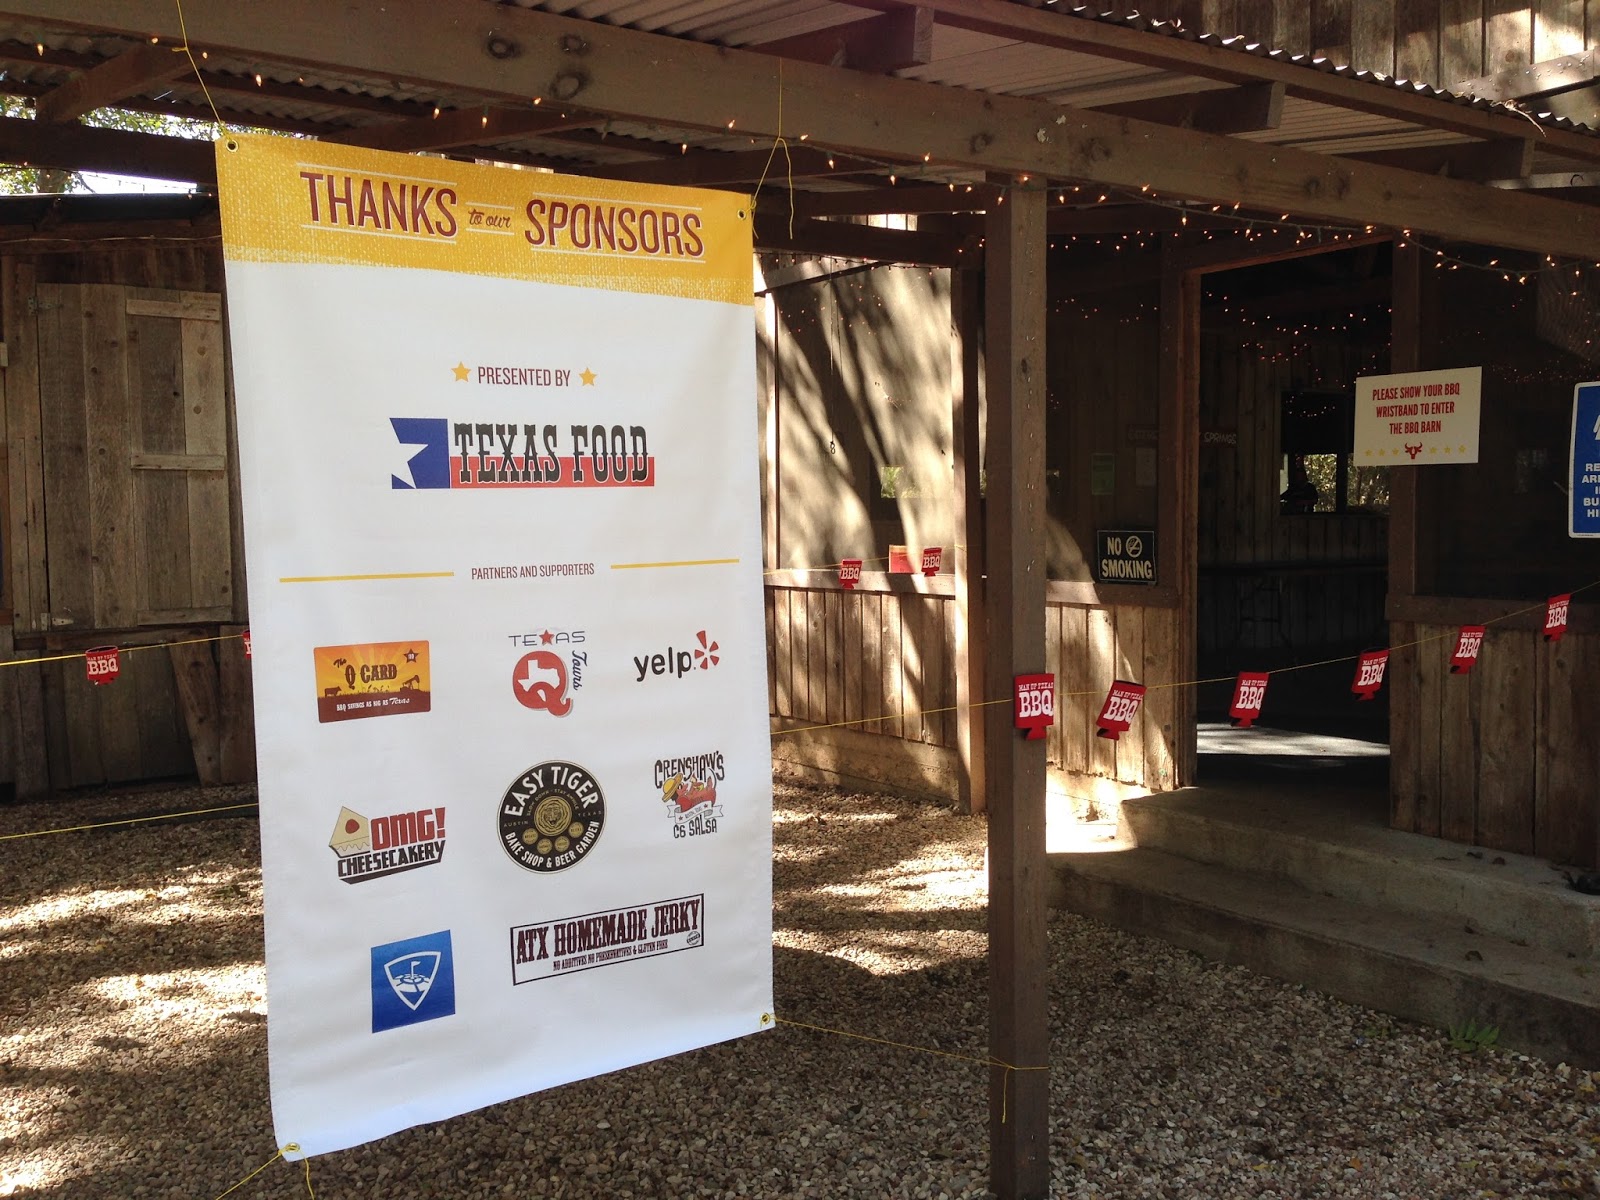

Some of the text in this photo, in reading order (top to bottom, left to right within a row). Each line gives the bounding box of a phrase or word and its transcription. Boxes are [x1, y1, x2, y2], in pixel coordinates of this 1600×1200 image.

[299, 171, 705, 257] THANKS to our SPONSORS
[477, 366, 571, 387] PRESENTED BY
[1372, 382, 1460, 401] PLEASE SHOW YOUR BBQ
[1376, 401, 1455, 418] WRISTBAND TO ENTER
[1389, 420, 1441, 435] THE BBQ BARN
[454, 422, 649, 484] TEXAS FOOD
[1107, 536, 1122, 556] NO
[471, 562, 595, 580] PARTNERS AND SUPPORTERS
[841, 567, 859, 580] BBQ
[922, 556, 940, 568] BBQ
[1101, 558, 1153, 579] SMOKING
[1545, 605, 1568, 629] BBQ
[1455, 638, 1481, 659] BBQ
[87, 657, 119, 675] BBQ
[333, 657, 347, 668] The
[571, 650, 588, 691] Tours
[633, 646, 692, 682] yelp
[1357, 662, 1386, 686] BBQ
[345, 663, 398, 690] Q CARD
[1018, 689, 1054, 718] BBQ
[1103, 696, 1139, 724] BBQ
[1235, 686, 1265, 711] BBQ
[654, 750, 725, 789] CRENSHAW'S
[504, 766, 599, 817] EASY TIGER
[370, 806, 446, 851] OMG!
[688, 814, 717, 837] SALSA
[505, 820, 600, 868] BAKE SHOP & BEER GARDEN
[337, 839, 446, 877] CHEESECAKERY
[516, 898, 701, 964] ATX HOMEMADE JERKY
